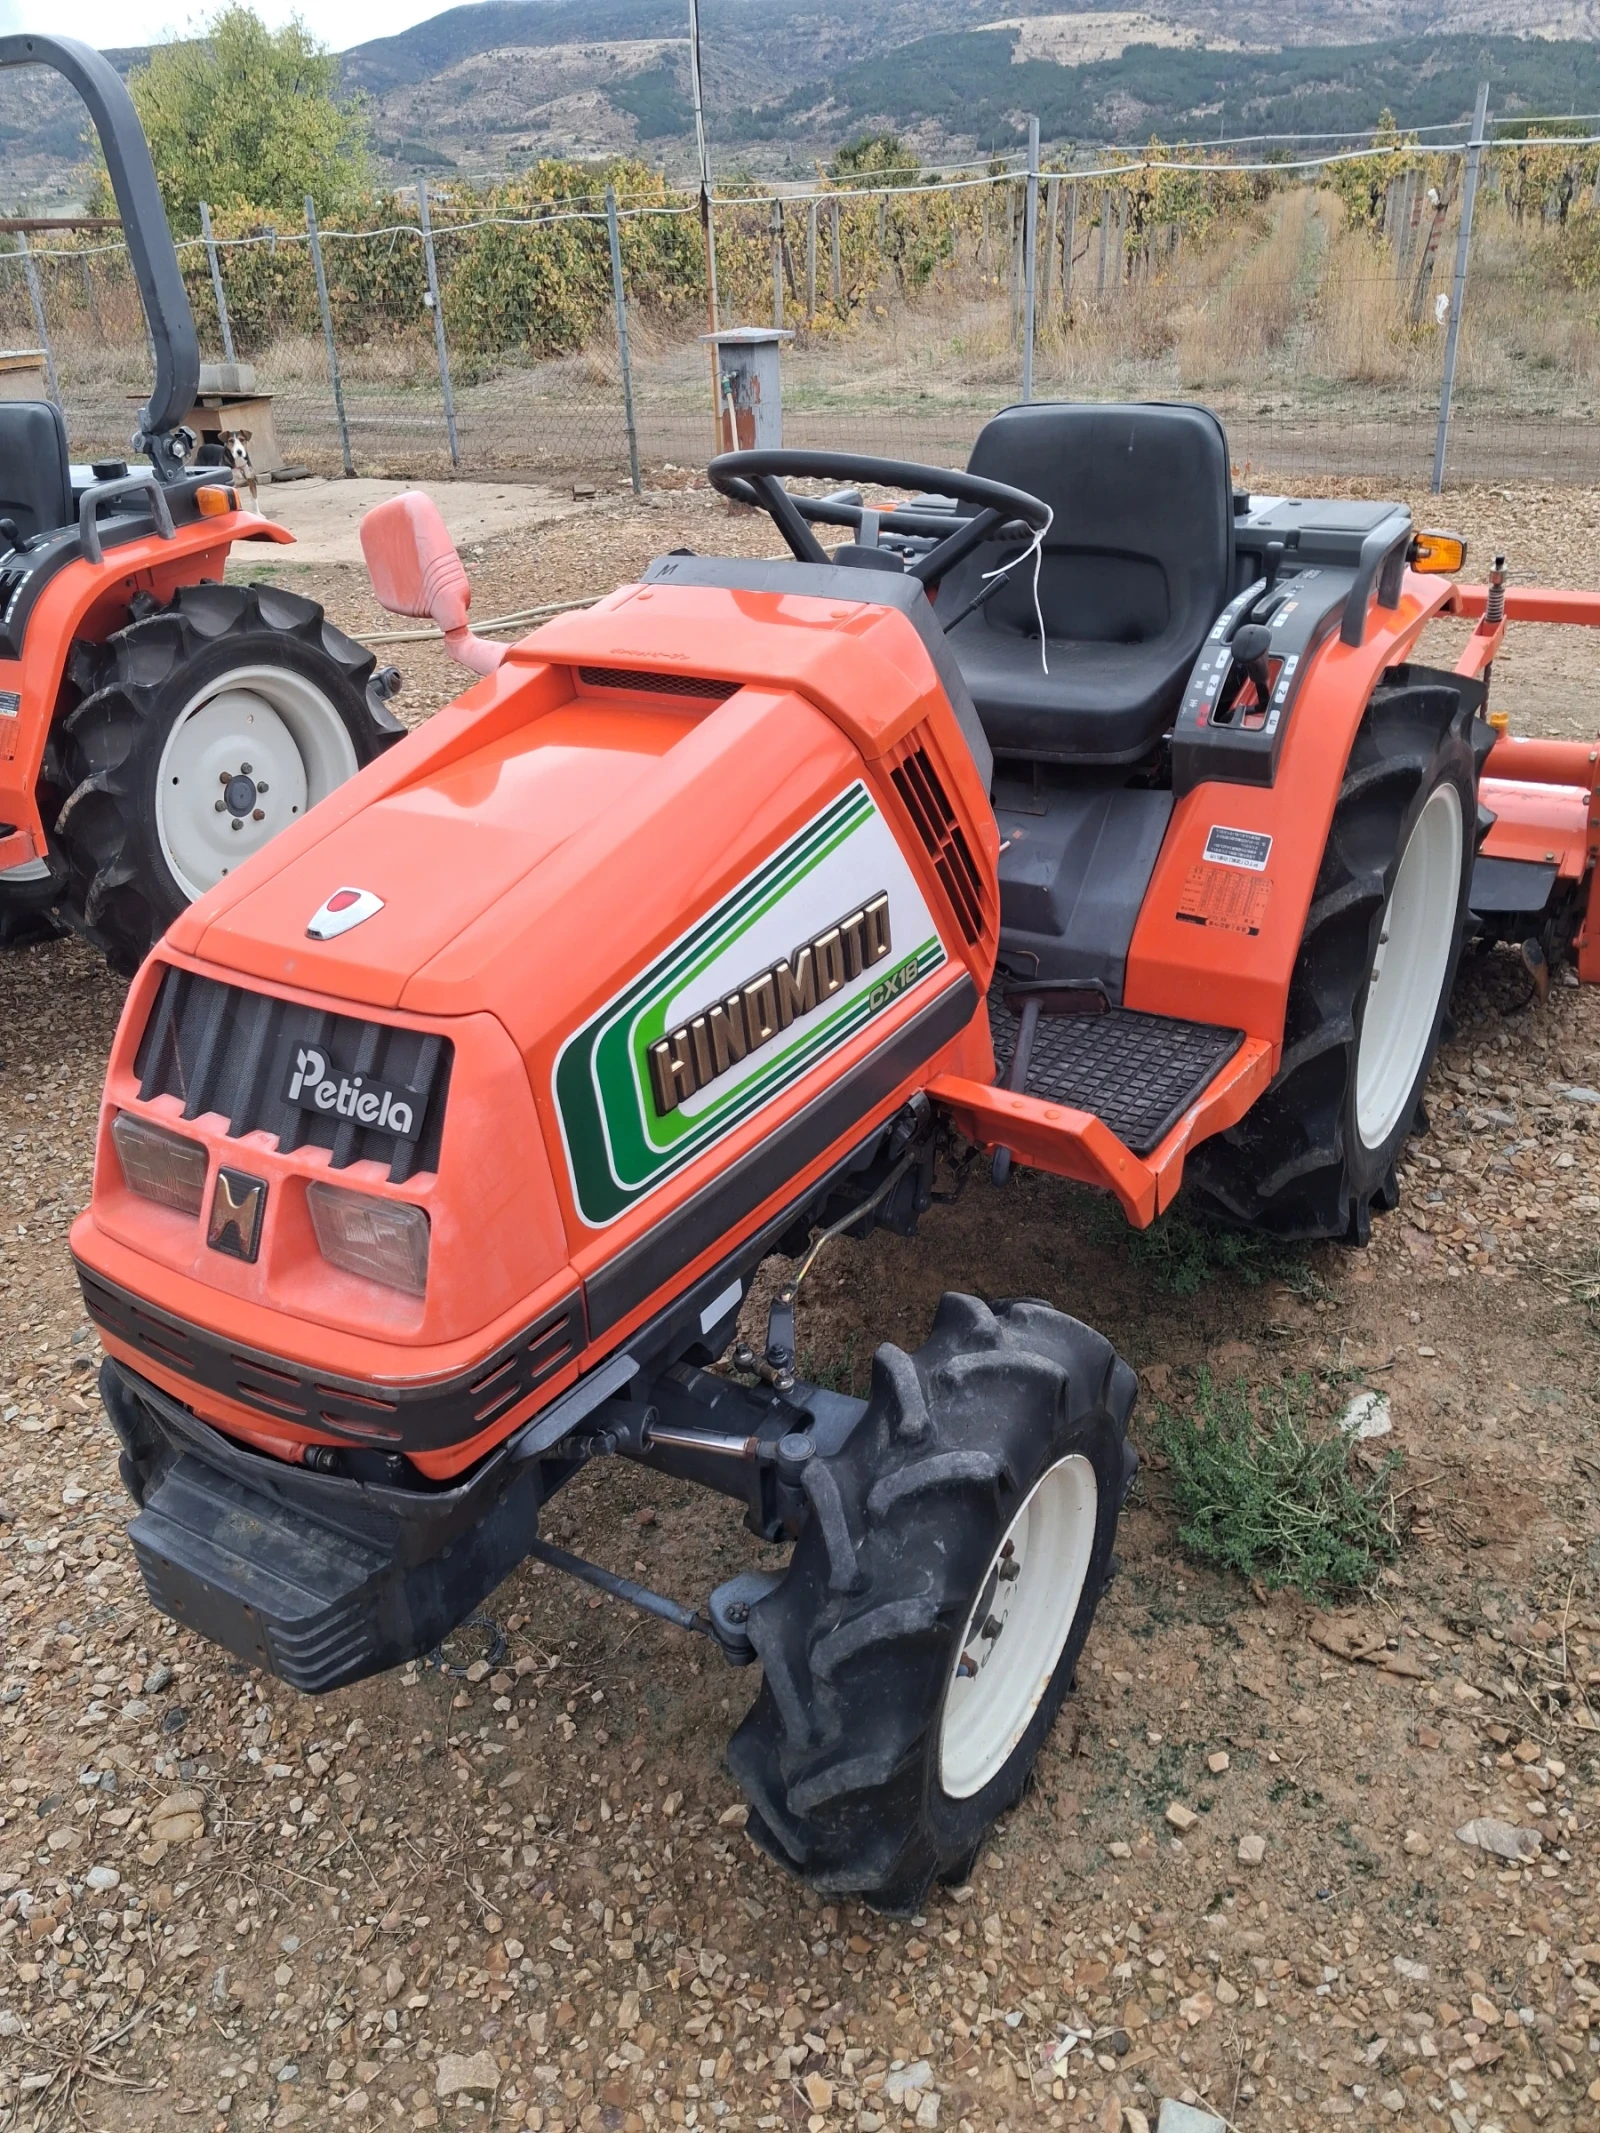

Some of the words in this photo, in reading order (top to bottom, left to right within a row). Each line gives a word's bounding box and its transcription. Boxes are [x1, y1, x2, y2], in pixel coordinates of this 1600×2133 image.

[650, 891, 892, 1114] HINOMOTO
[870, 957, 919, 1011] CX18
[288, 1048, 413, 1134] Petiela
